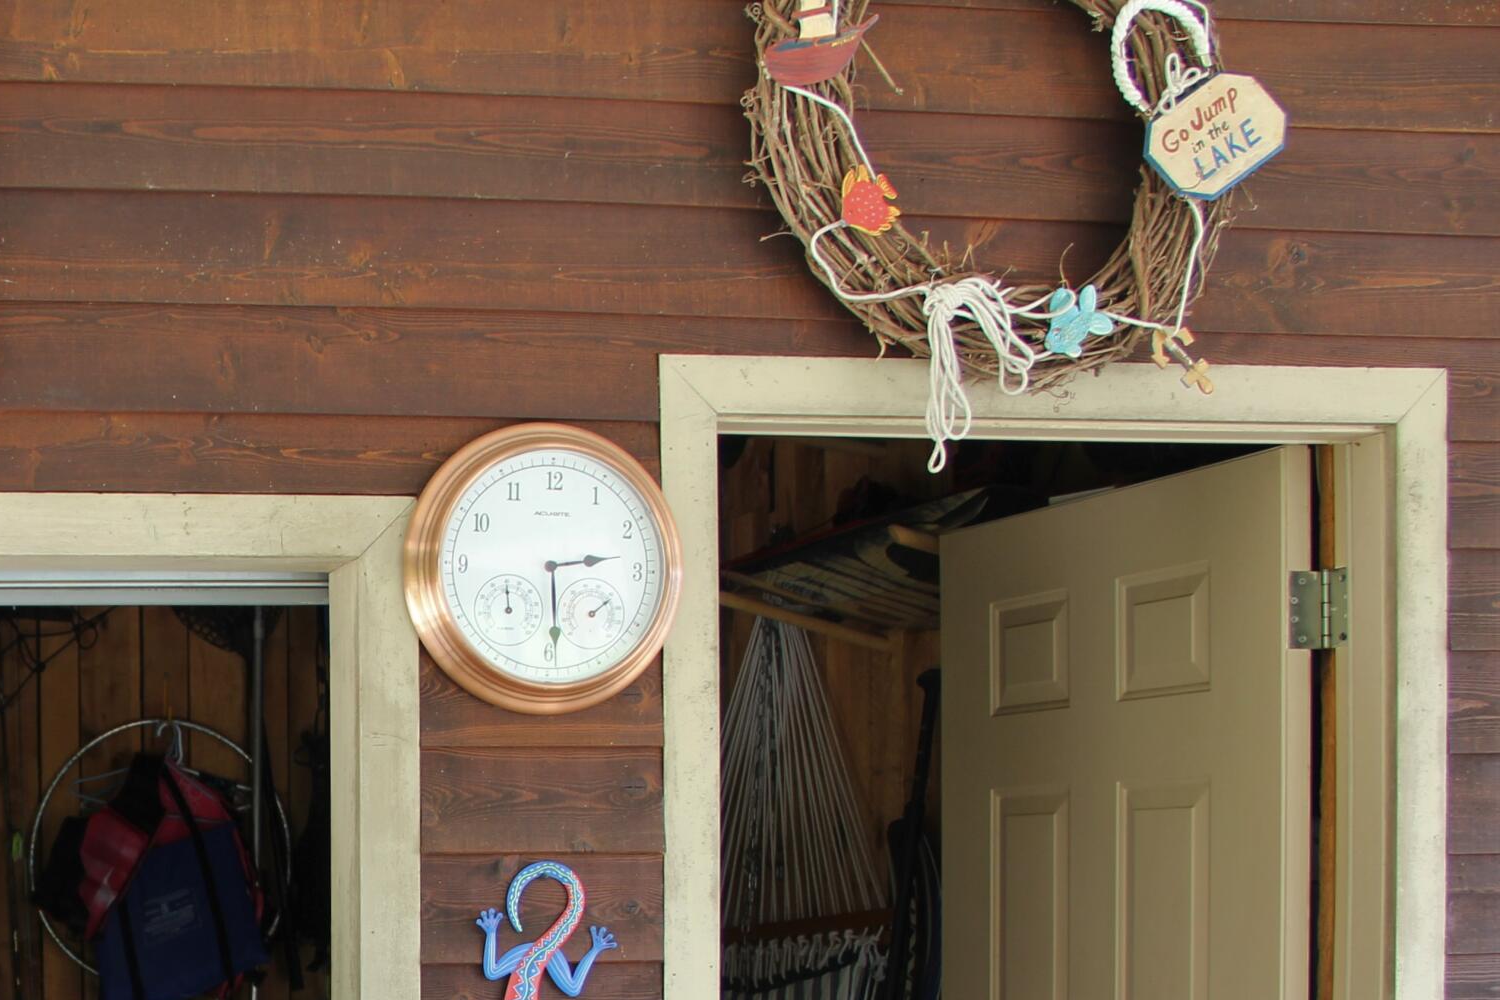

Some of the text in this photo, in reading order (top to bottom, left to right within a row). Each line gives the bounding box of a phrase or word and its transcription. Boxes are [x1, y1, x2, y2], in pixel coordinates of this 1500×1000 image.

[1161, 127, 1189, 153] Go
[1191, 120, 1230, 154] in the
[1193, 117, 1262, 181] LAKE
[506, 481, 521, 502] 11
[546, 471, 564, 491] 12
[591, 485, 599, 506] 1
[472, 512, 490, 533] 10
[622, 520, 633, 540] 2
[458, 553, 468, 574] 9
[632, 562, 643, 581] 3
[544, 642, 554, 662] 6
